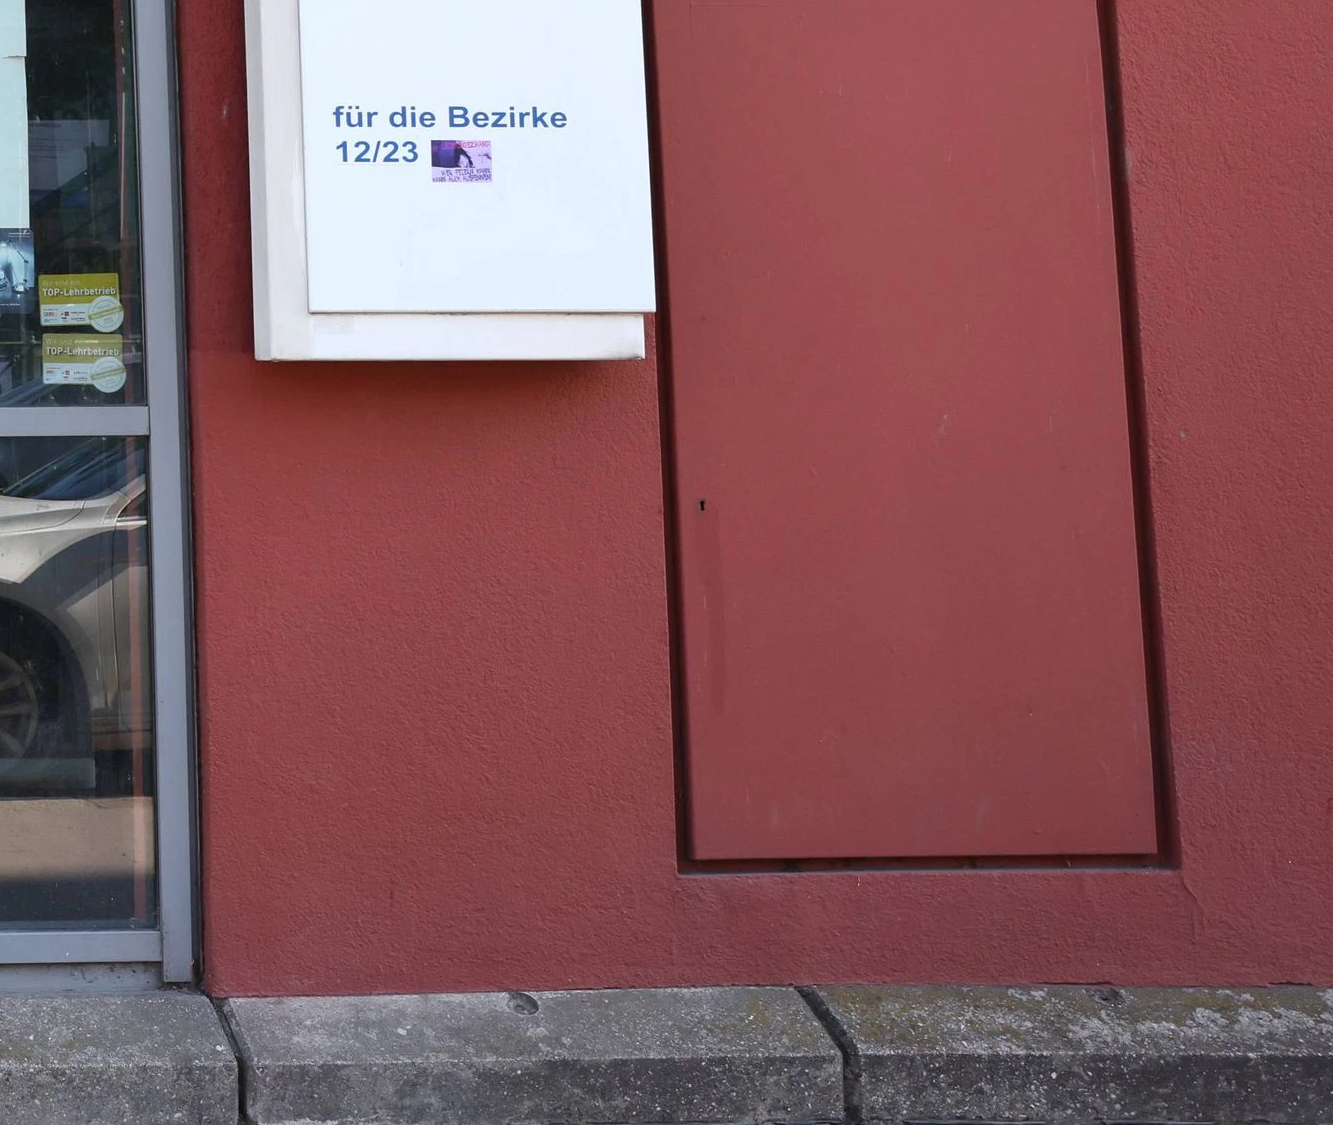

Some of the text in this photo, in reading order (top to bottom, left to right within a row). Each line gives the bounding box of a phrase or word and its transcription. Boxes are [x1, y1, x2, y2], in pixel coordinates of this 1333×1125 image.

[333, 105, 567, 128] für die Bezirke
[336, 140, 419, 163] 12/23
[42, 287, 116, 297] TOP-Lehrbetrieb
[45, 346, 119, 356] TOP-Lehrbetrieb
